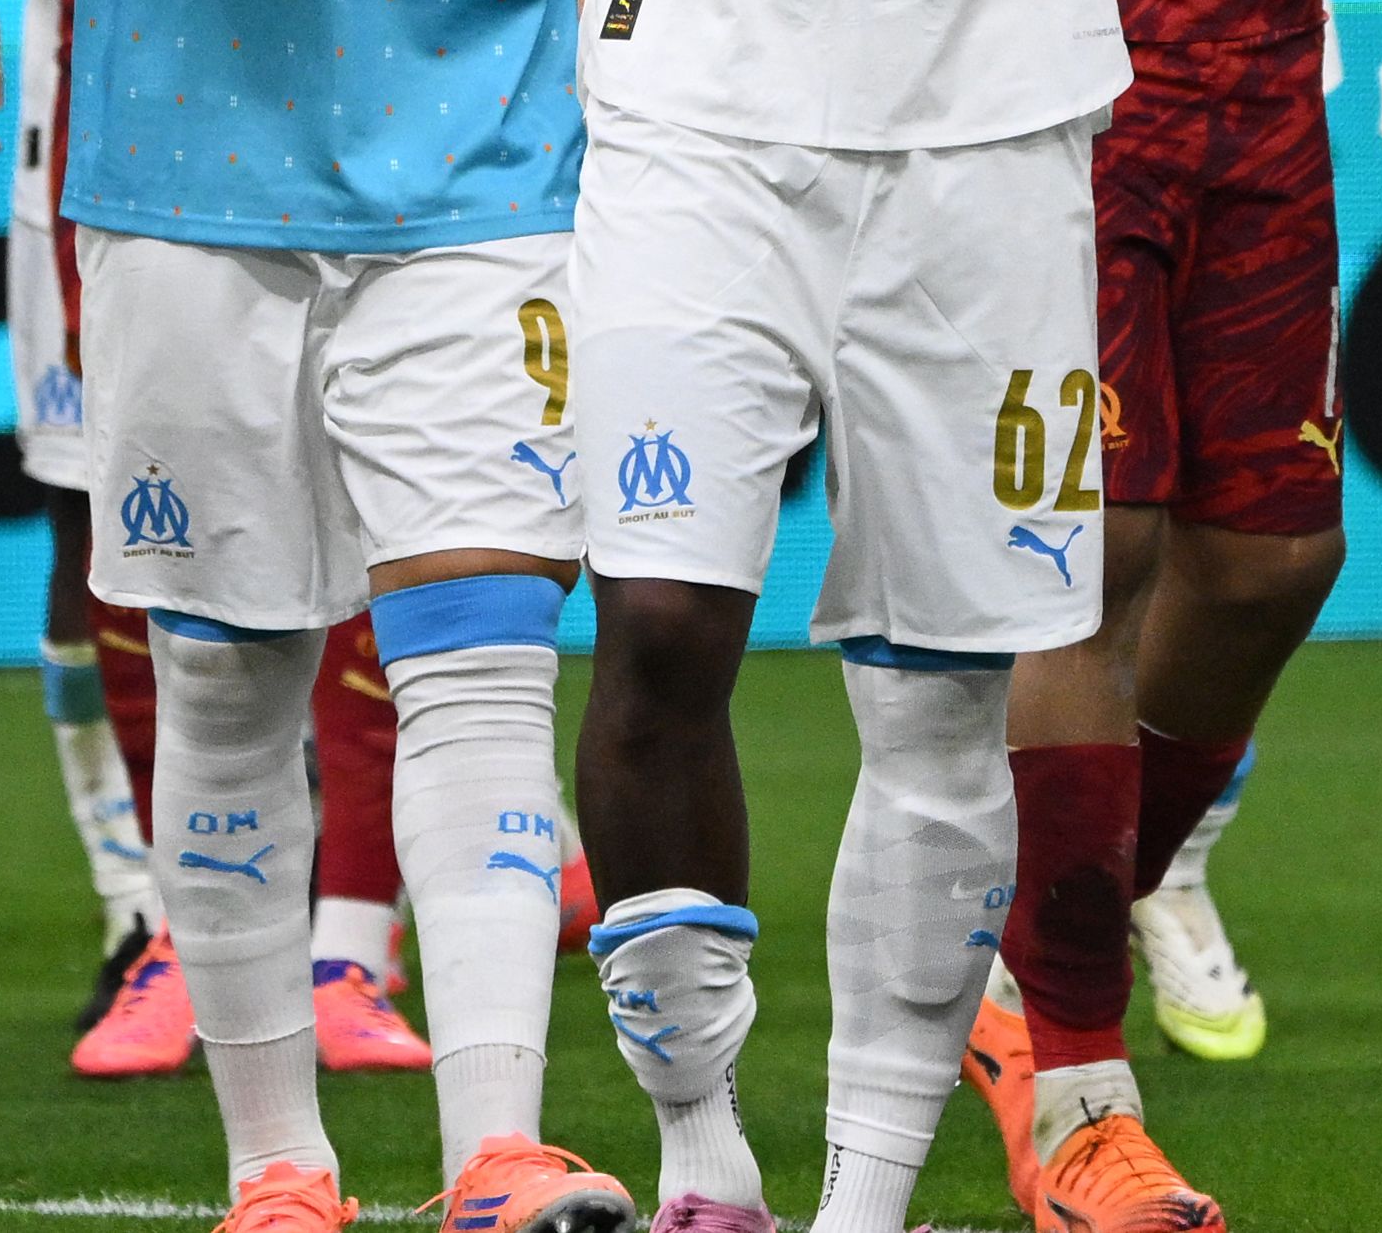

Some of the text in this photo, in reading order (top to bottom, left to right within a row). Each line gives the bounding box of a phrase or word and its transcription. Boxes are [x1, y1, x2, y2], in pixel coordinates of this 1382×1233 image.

[517, 297, 569, 425] 9
[992, 368, 1101, 511] 62
[618, 509, 695, 525] DROIT AU BUT
[123, 548, 195, 559] DROIT AU BUT
[188, 809, 259, 834] OM
[498, 810, 555, 843] OM
